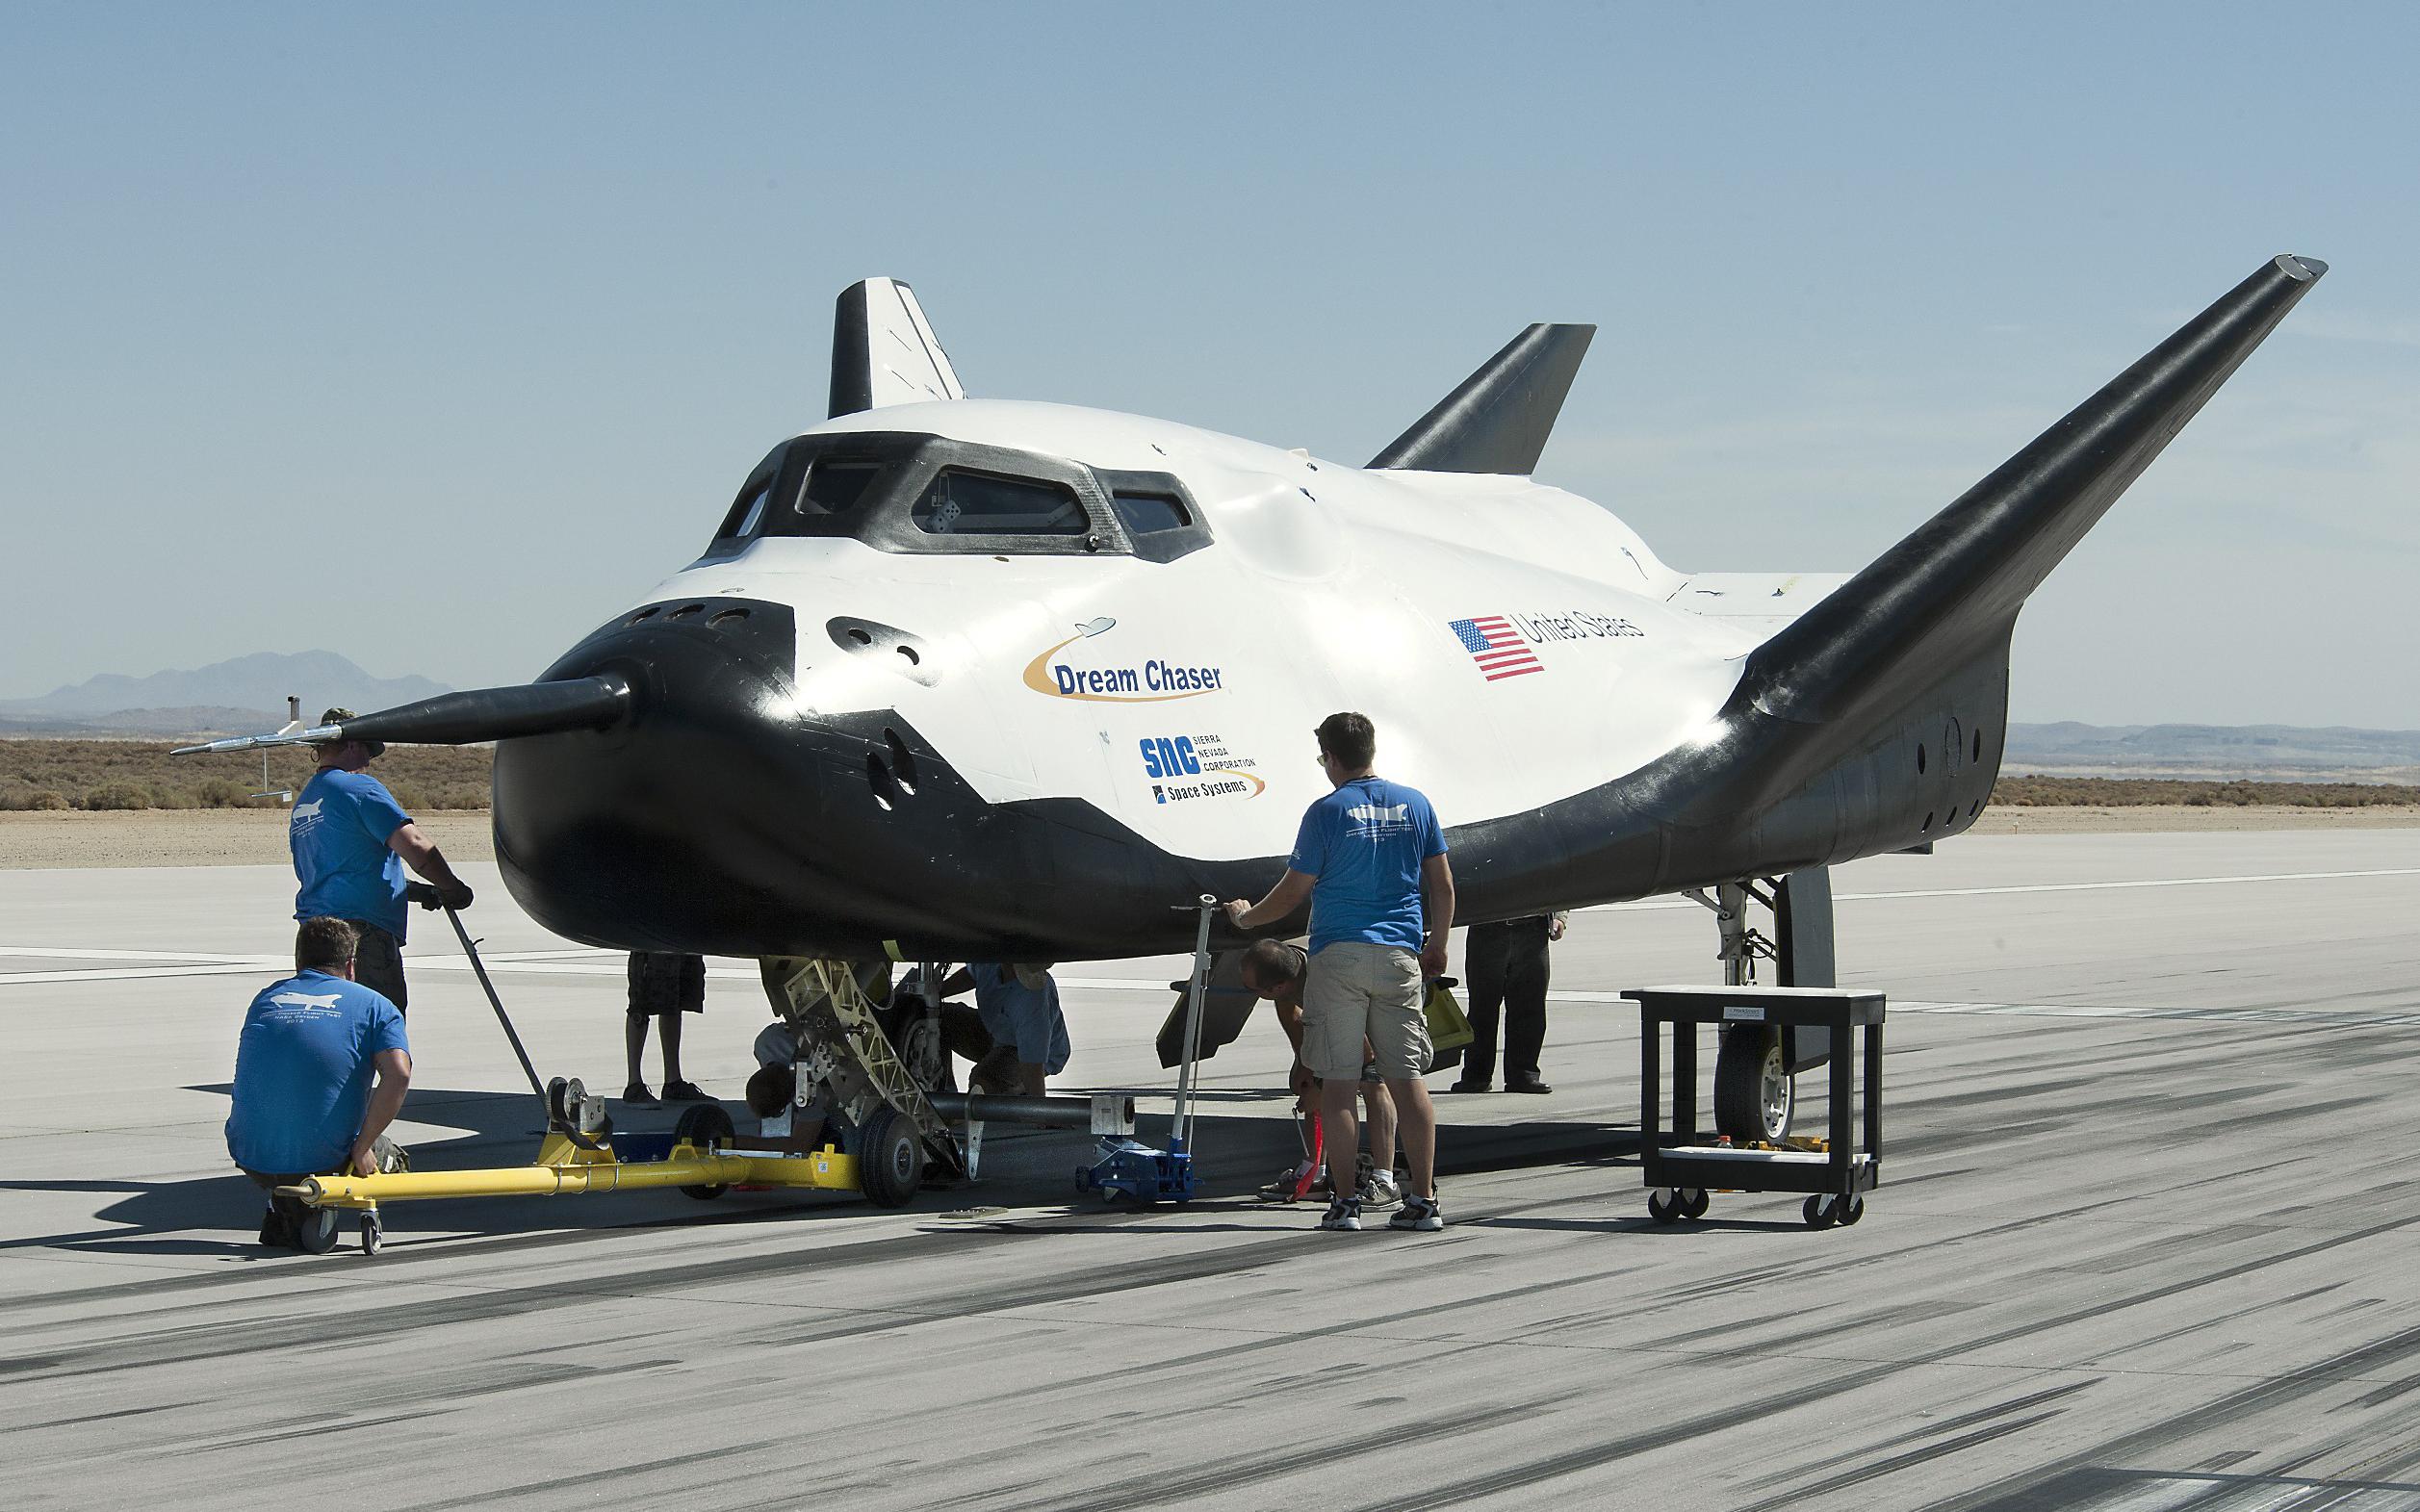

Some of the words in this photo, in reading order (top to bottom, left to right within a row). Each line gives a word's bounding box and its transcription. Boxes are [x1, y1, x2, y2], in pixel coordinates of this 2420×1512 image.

[1509, 610, 1588, 643] United
[1572, 610, 1645, 637] States
[1055, 664, 1139, 695] Dream
[1145, 660, 1223, 692] Chaser
[1193, 734, 1221, 745] SIERRA
[1197, 748, 1229, 758] NEVADA
[1203, 758, 1256, 772] CORPORATION
[1168, 785, 1201, 801] Space
[1201, 781, 1248, 797] Systems
